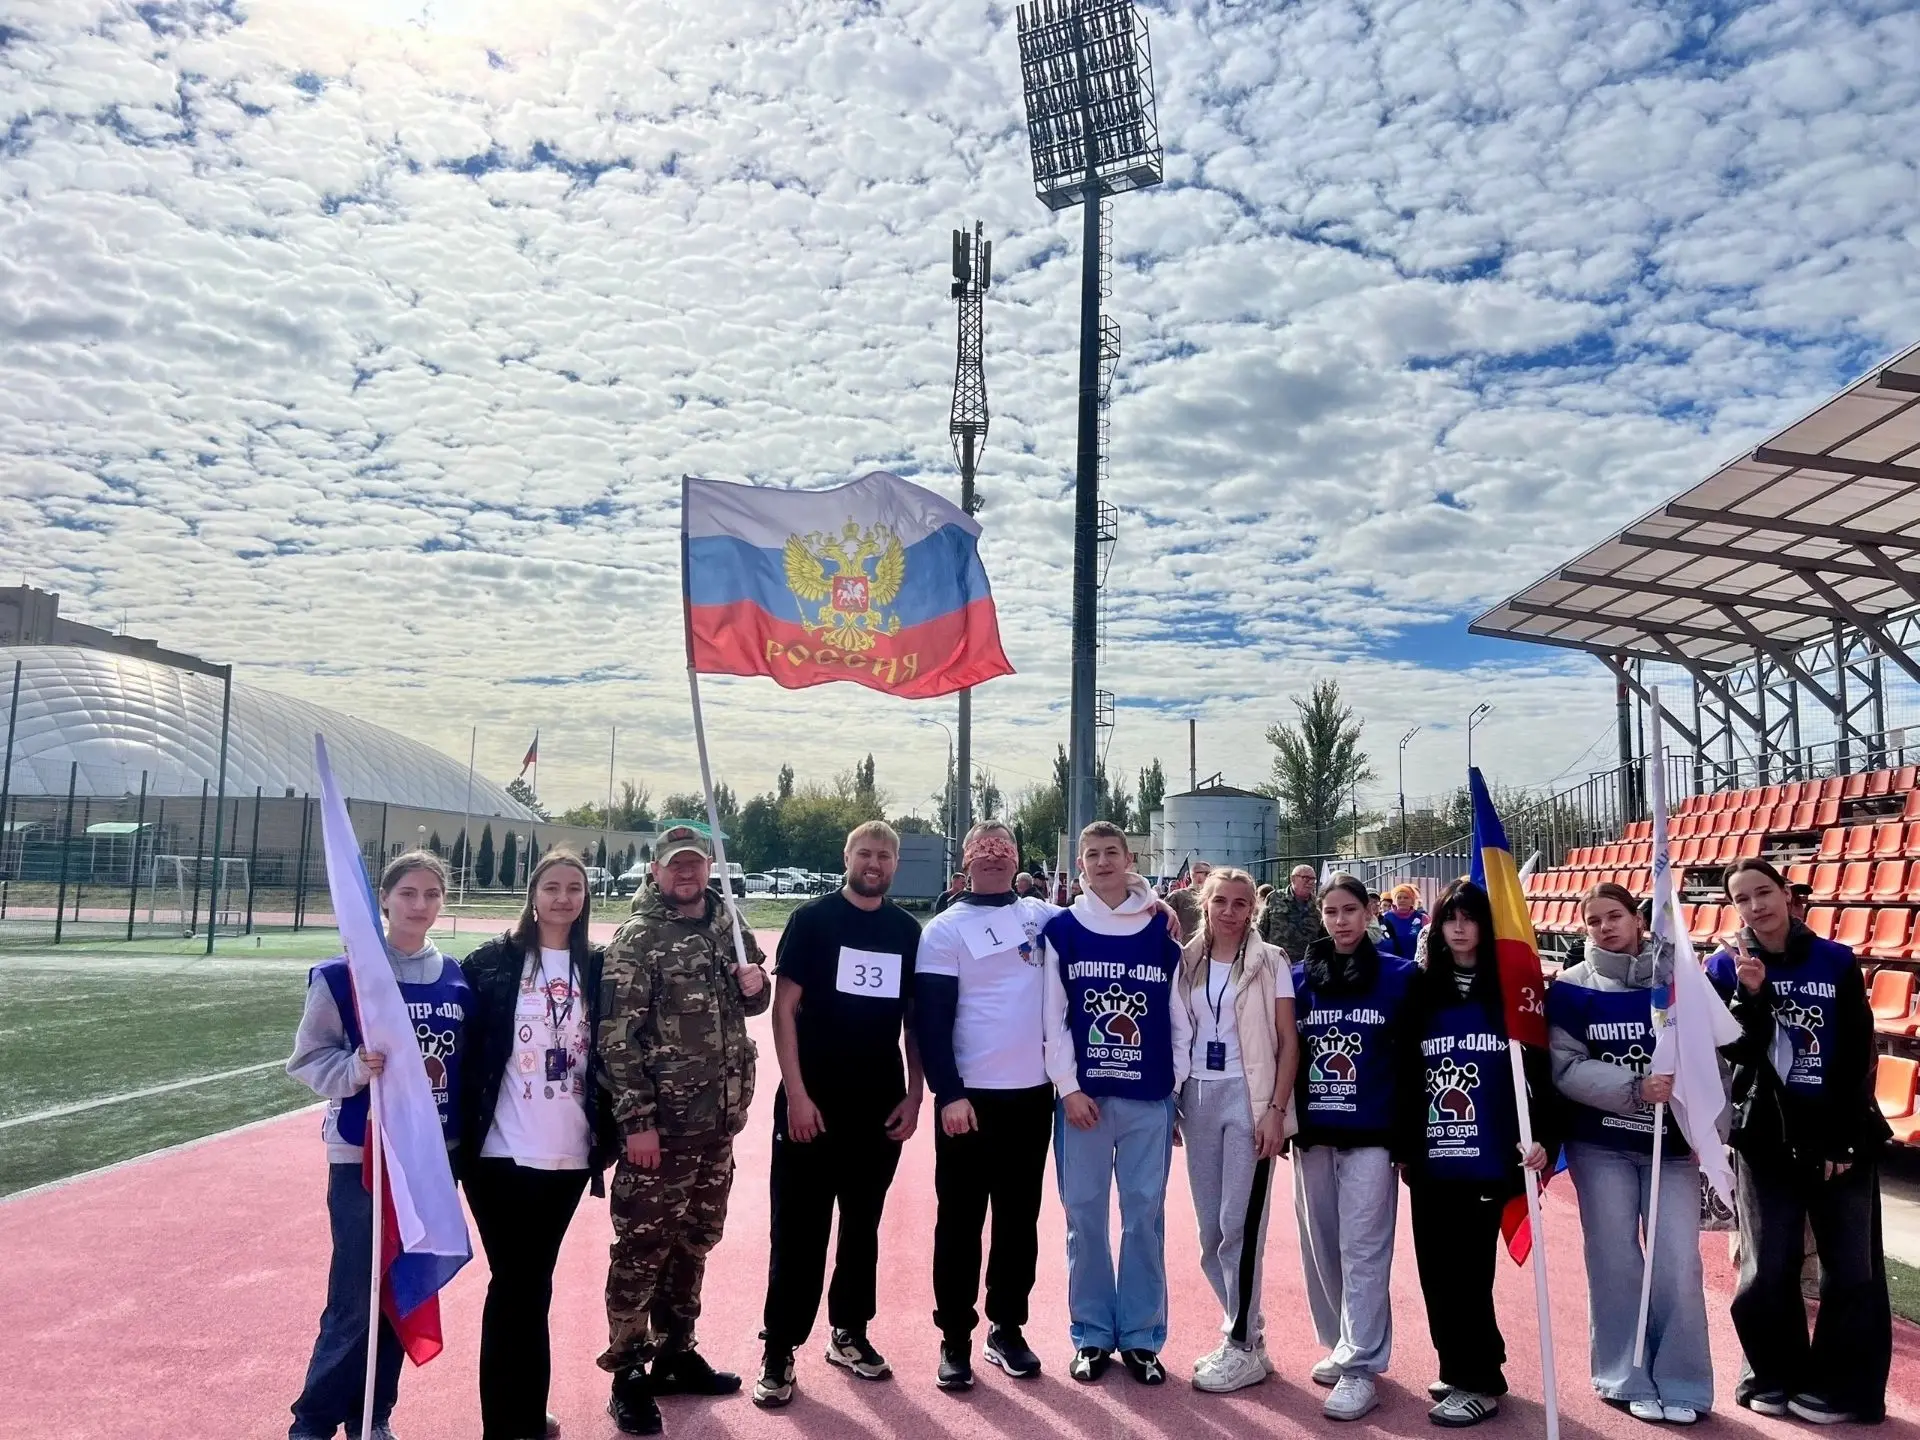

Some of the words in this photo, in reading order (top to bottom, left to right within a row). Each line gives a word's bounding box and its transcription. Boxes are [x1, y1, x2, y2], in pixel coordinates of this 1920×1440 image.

[765, 639, 920, 684] РОССИЯ
[985, 927, 1003, 946] 1
[853, 964, 883, 988] 33
[1799, 981, 1837, 999] «ОДН
[407, 1002, 433, 1019] ТЕР
[1344, 1008, 1386, 1025] «ОДН»
[1585, 1022, 1646, 1041] ЛОНТЕР
[1457, 1033, 1506, 1052] «ОДН»
[1087, 1047, 1110, 1059] МО
[1111, 1048, 1142, 1062] ОДН
[1308, 1083, 1329, 1094] МО
[1330, 1083, 1357, 1096] ОДН
[1426, 1126, 1445, 1138] МО
[1446, 1124, 1478, 1139] ОДН
